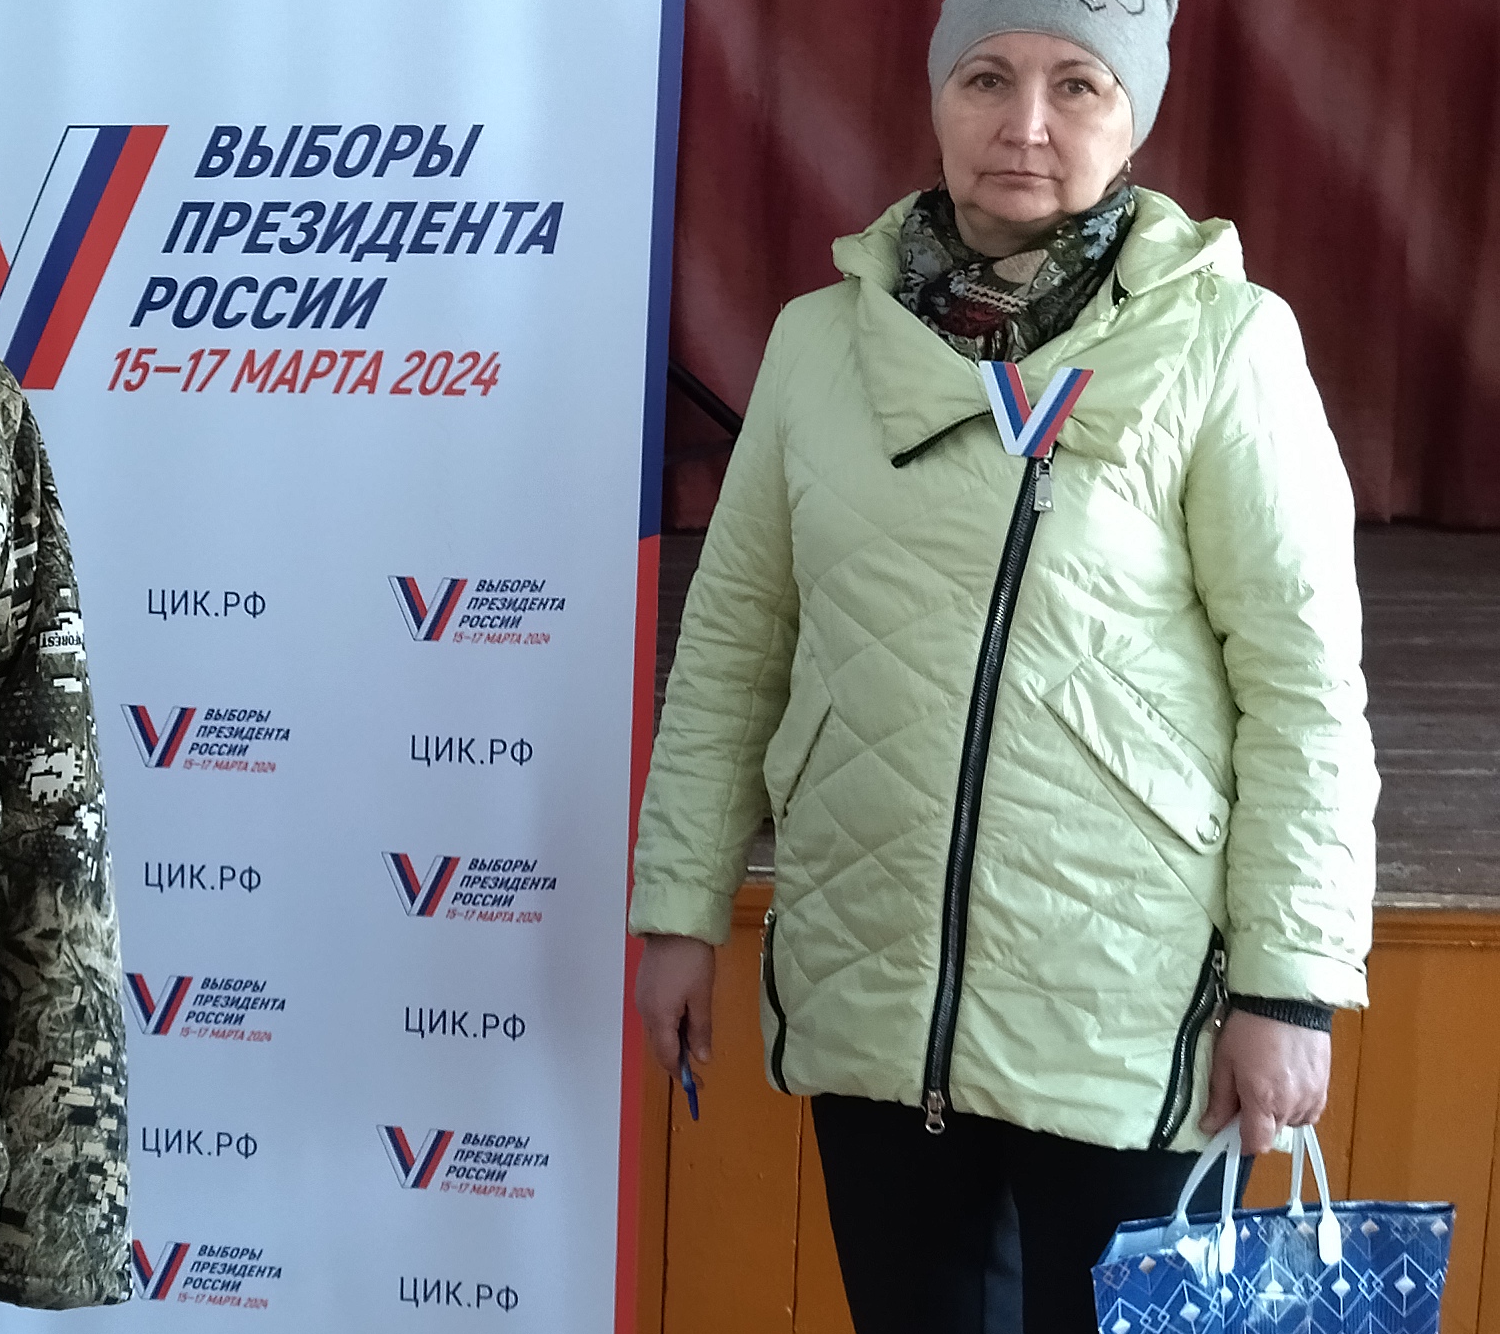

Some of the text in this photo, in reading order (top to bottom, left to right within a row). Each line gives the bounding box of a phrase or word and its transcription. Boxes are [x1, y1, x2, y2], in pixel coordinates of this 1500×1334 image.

[194, 124, 484, 178] ВЫБОРЫ
[161, 201, 564, 260] ПРЕЗИДЕНТА
[129, 276, 387, 329] РОССИИ
[230, 349, 383, 394] МАРТА
[390, 350, 500, 396] 2024
[475, 580, 545, 593] ВЫБОРЫ
[149, 589, 265, 621] ЦИК.РФ
[467, 597, 565, 612] ПРЕЗИДЕНТА
[459, 615, 522, 629] РОССИИ
[40, 633, 83, 649] FOREST
[484, 633, 522, 644] МАРТА
[524, 633, 550, 644] 2024
[204, 709, 271, 722] ВЫБОРЫ
[196, 725, 290, 741] ПРЕЗИДЕНТА
[188, 743, 249, 756] РОССИИ
[412, 735, 532, 767] ЦИК.РФ
[213, 760, 249, 771] МАРТА
[251, 762, 276, 773] 2024
[468, 858, 537, 872] ВЫБОРЫ
[145, 862, 261, 893] ЦИК.РФ
[460, 875, 556, 891] ПРЕЗИДЕНТА
[452, 892, 514, 907] РОССИИ
[477, 911, 514, 922] МАРТА
[516, 912, 542, 923] 2024
[201, 978, 266, 993] ВЫБОРЫ
[193, 994, 285, 1011] ПРЕЗИДЕНТА
[185, 1011, 245, 1025] РОССИИ
[405, 1007, 525, 1041] ЦИК.РФ
[209, 1029, 245, 1040] МАРТА
[247, 1031, 272, 1042] 2024
[143, 1127, 257, 1159] ЦИК.РФ
[462, 1133, 530, 1149] ВЫБОРЫ
[454, 1149, 549, 1167] ПРЕЗИДЕНТА
[446, 1166, 507, 1182] РОССИИ
[470, 1184, 507, 1197] МАРТА
[198, 1245, 263, 1261] ВЫБОРЫ
[190, 1261, 281, 1278] ПРЕЗИДЕНТА
[183, 1277, 241, 1292] РОССИИ
[400, 1277, 518, 1312] ЦИК.РФ
